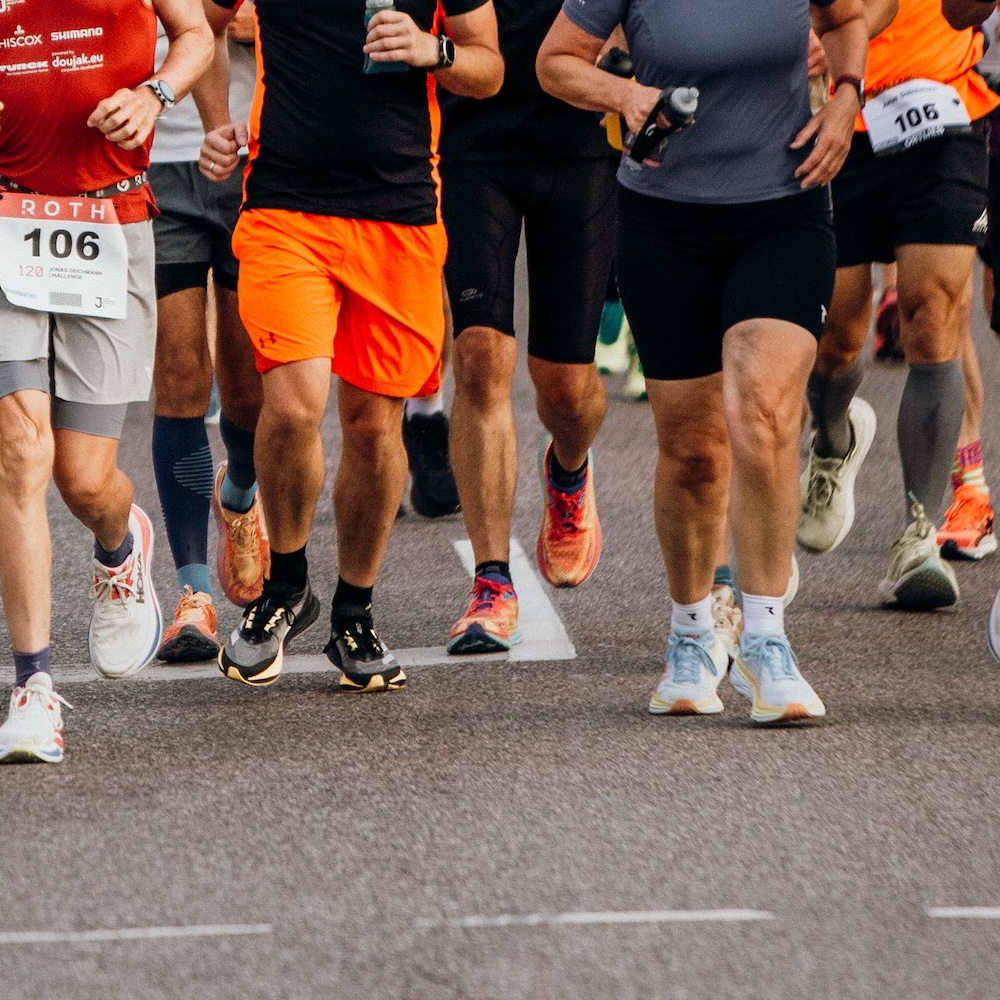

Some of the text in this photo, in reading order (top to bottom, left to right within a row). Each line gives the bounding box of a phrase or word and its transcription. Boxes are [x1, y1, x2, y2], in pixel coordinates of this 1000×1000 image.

[50, 27, 103, 42] SHIMANO
[52, 53, 104, 68] doujak.eu
[894, 103, 940, 134] 106
[21, 199, 105, 221] ROTH
[23, 228, 100, 262] 106
[19, 265, 44, 278] 120
[49, 266, 68, 274] JONAS
